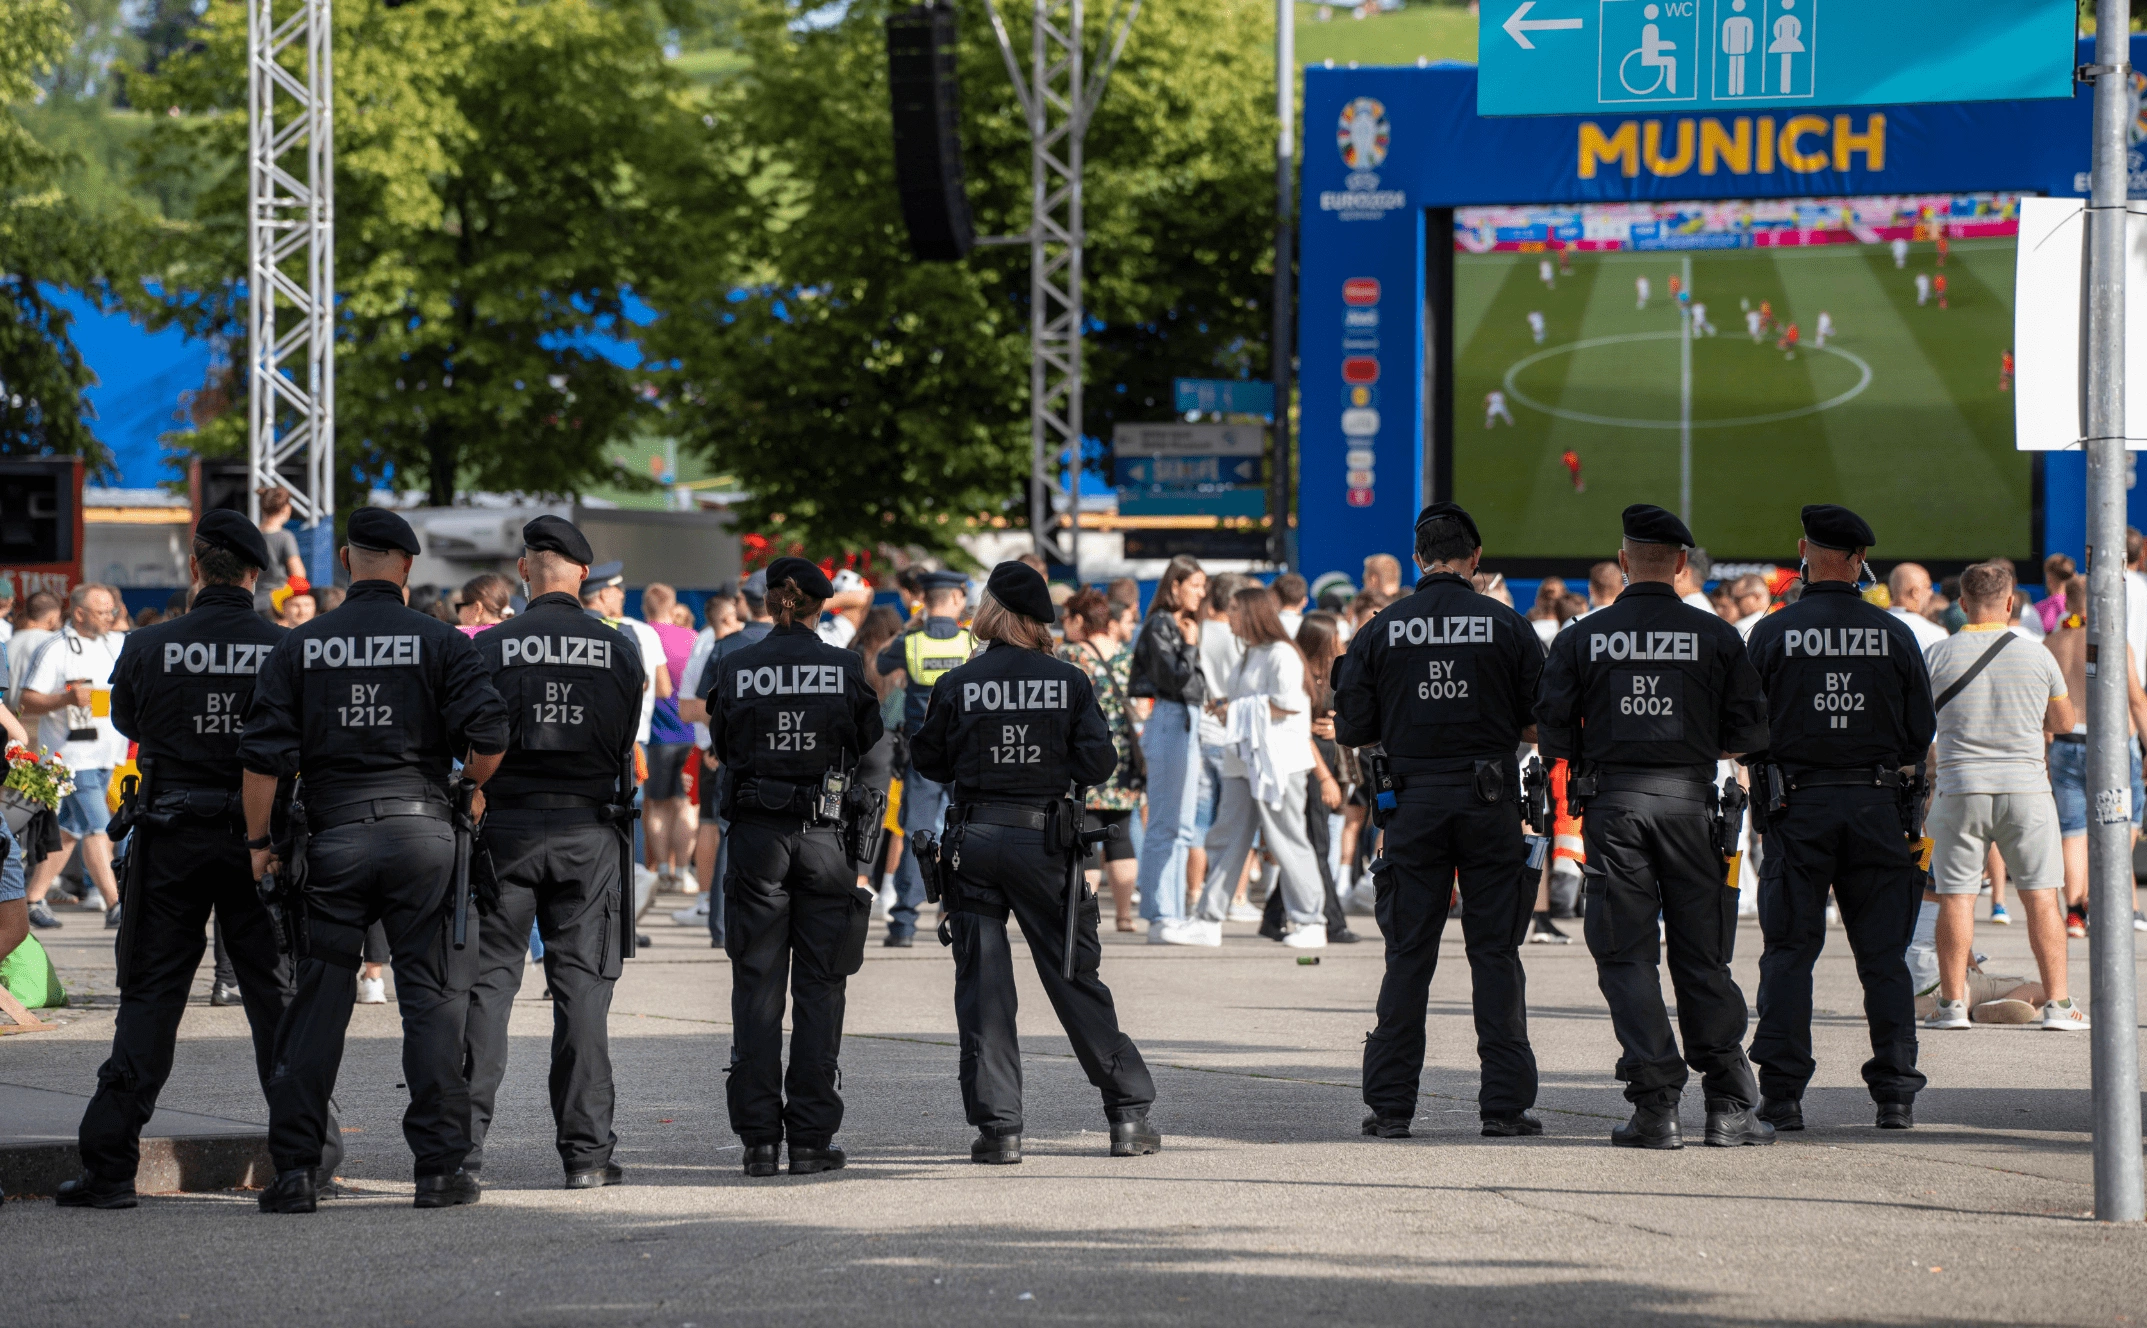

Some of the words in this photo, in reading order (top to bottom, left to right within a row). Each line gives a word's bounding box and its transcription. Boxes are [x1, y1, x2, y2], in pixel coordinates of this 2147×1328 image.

[1665, 2, 1693, 17] WC
[1577, 112, 1887, 180] MUNICH
[1388, 615, 1493, 647] POLIZEI
[1785, 627, 1889, 657] POLIZEI
[303, 635, 421, 669] POLIZEI
[501, 635, 611, 669] POLIZEI
[1590, 631, 1699, 662] POLIZEI
[163, 642, 275, 674] POLIZE
[736, 664, 844, 698] POLIZEI
[1428, 660, 1455, 680] BY
[545, 681, 573, 703] BY
[1418, 680, 1469, 700] 6002
[1632, 675, 1660, 695] BY
[1826, 672, 1852, 692] BY
[207, 692, 236, 713] BY
[351, 683, 381, 705] BY
[963, 679, 1068, 712] POLIZEI
[1813, 692, 1865, 712] 6002
[337, 705, 393, 727] 1212
[532, 703, 584, 725] 1213
[1620, 696, 1673, 716] 6002
[778, 711, 806, 731] BY
[765, 732, 817, 752] 1213
[1002, 724, 1029, 745] BY
[989, 745, 1041, 764] 1212
